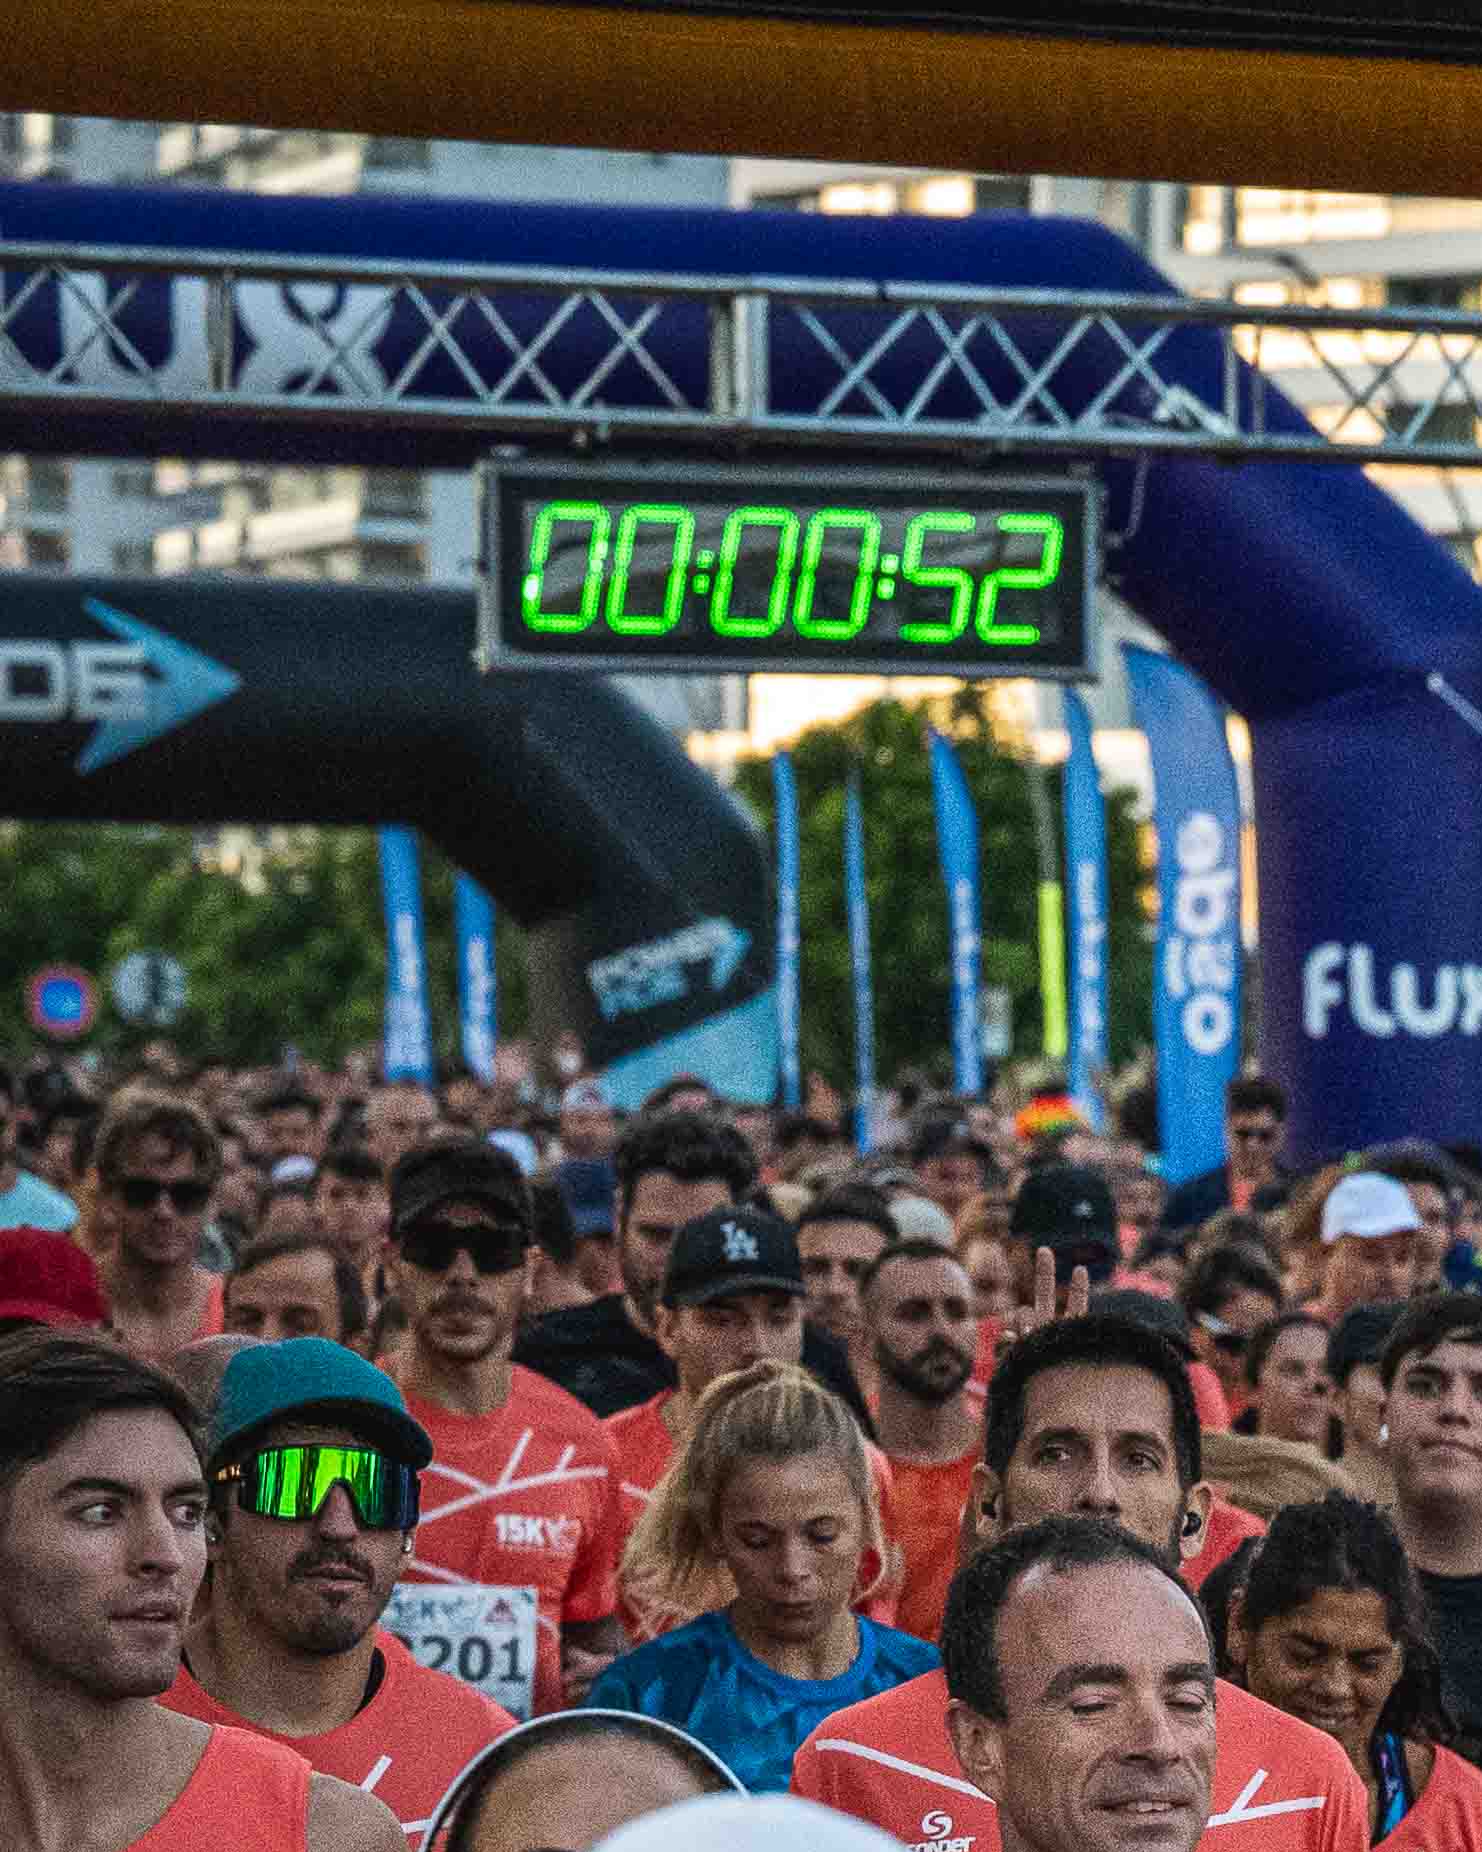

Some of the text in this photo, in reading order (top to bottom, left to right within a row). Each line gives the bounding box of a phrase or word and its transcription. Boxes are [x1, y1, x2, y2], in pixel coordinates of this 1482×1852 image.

[0, 268, 393, 398] UX
[521, 500, 1064, 646] 00:00:52
[400, 1635, 527, 1682] 201
